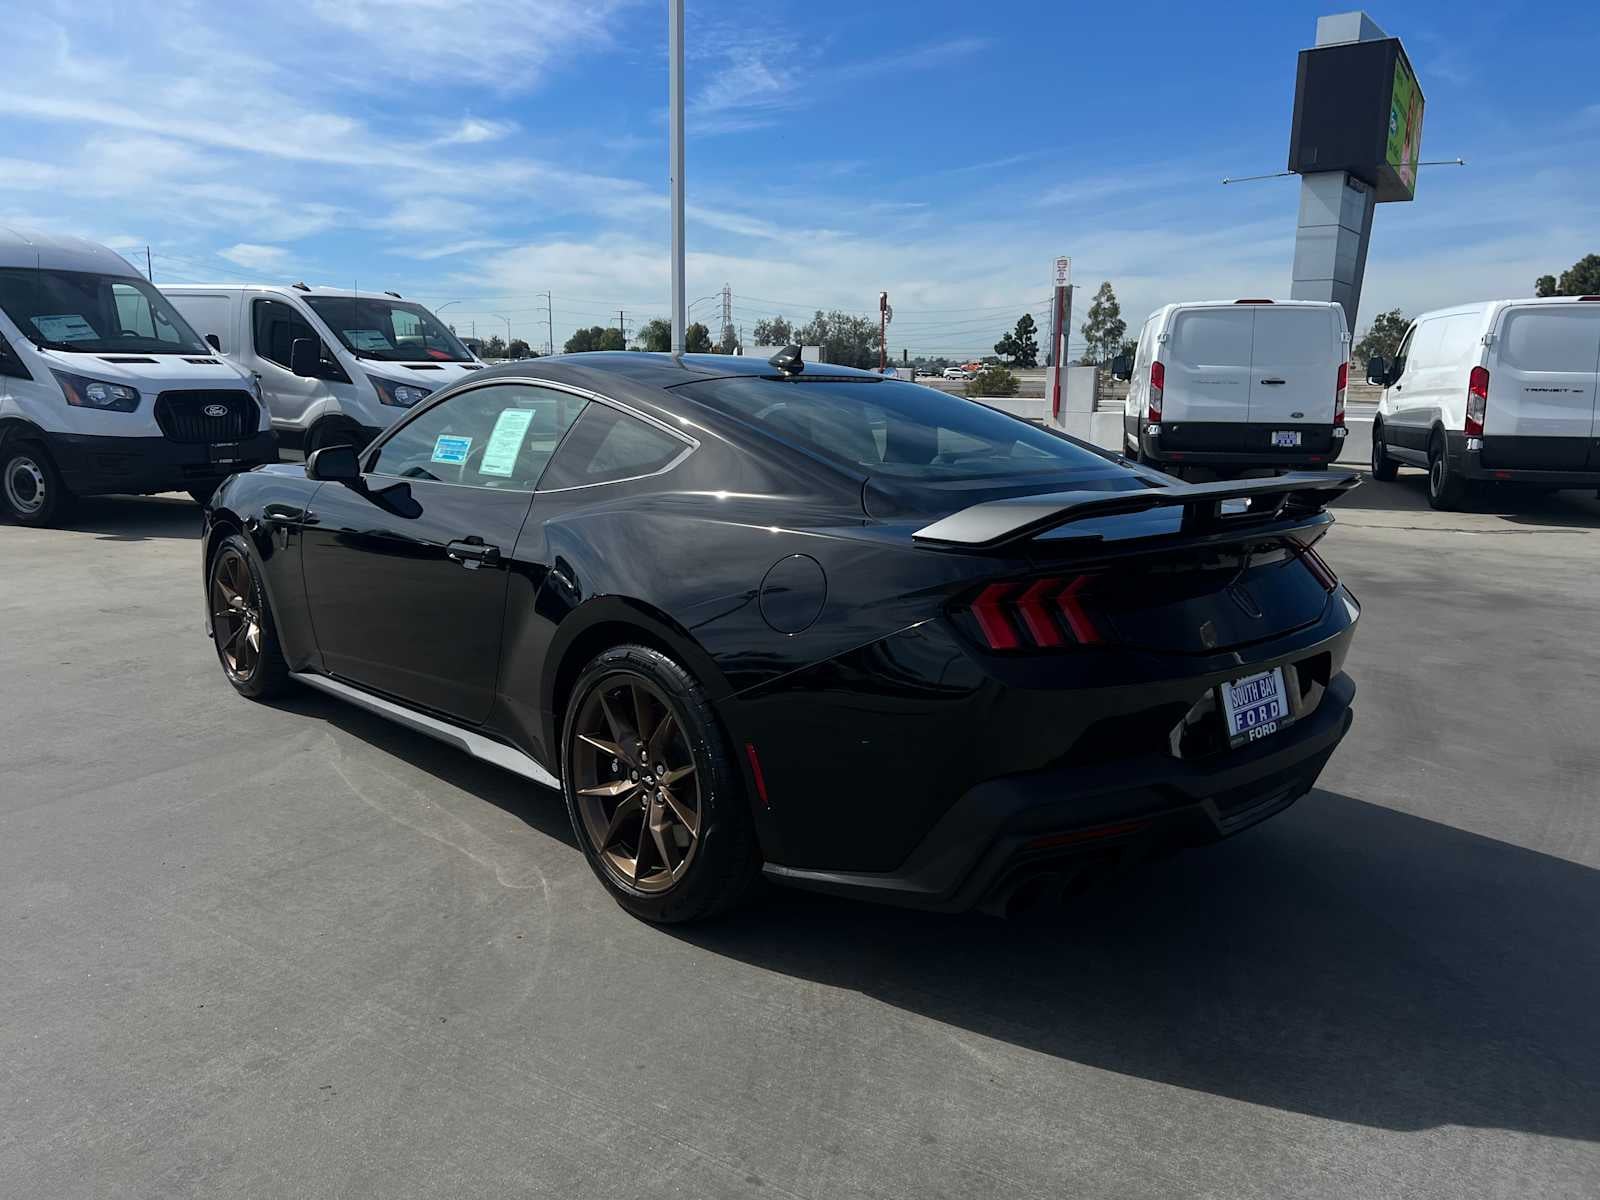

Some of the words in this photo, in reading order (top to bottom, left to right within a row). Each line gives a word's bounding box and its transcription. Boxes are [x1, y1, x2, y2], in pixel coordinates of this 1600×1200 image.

[1231, 683, 1259, 708] SOUTH
[1260, 676, 1276, 698] BAY
[1236, 702, 1279, 729] FORD
[1248, 722, 1277, 741] FORD
